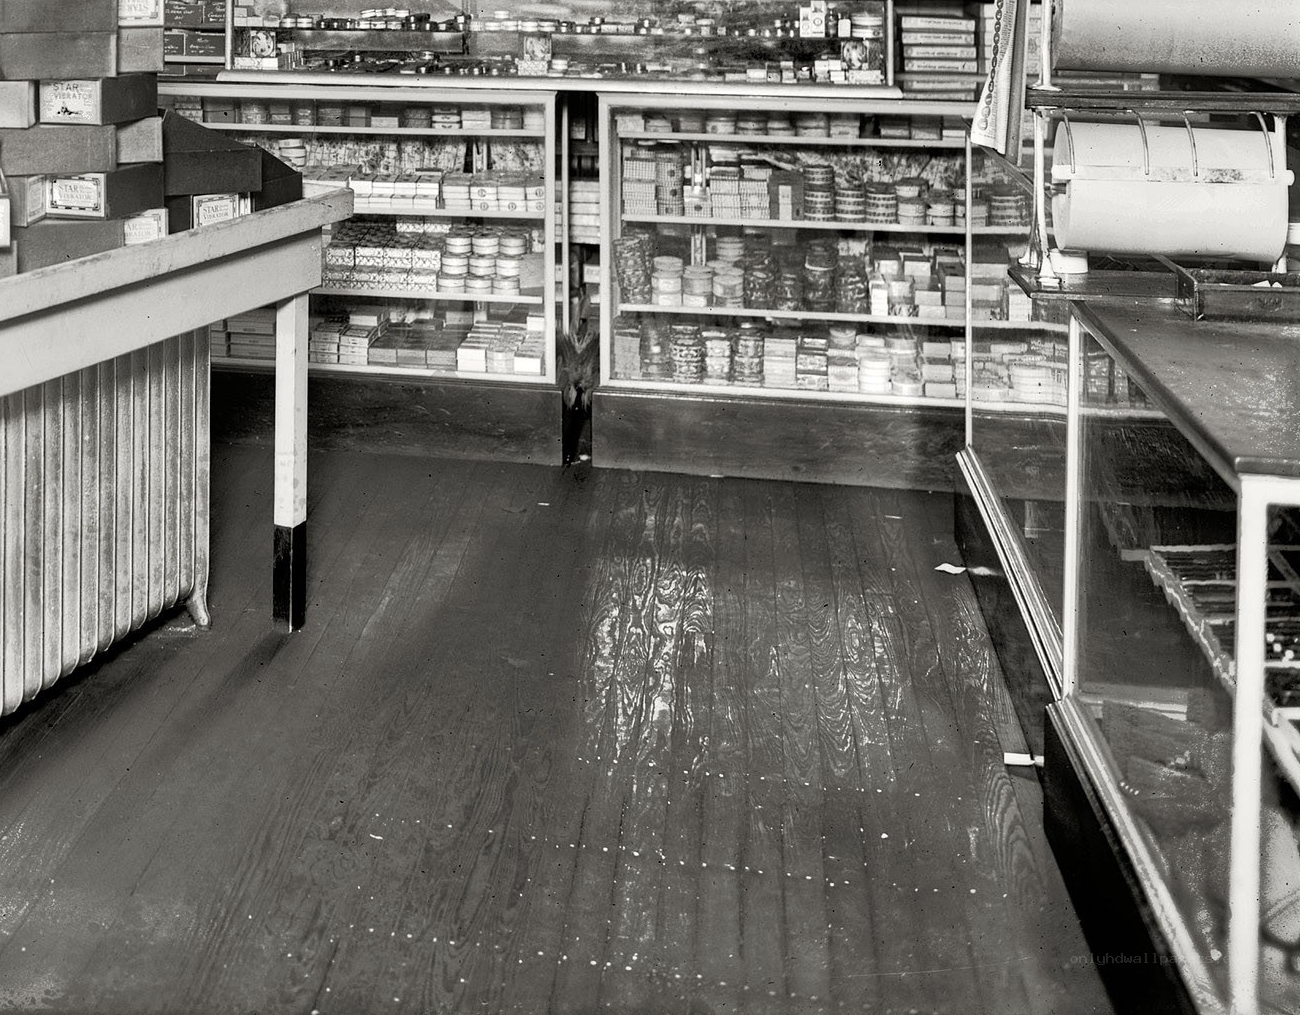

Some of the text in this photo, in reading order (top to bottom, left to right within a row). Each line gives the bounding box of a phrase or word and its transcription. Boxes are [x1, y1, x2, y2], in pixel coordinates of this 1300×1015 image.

[53, 82, 79, 91] STAR
[53, 91, 94, 100] VIBRATOR
[59, 184, 79, 193] STAR
[202, 204, 220, 214] STAR
